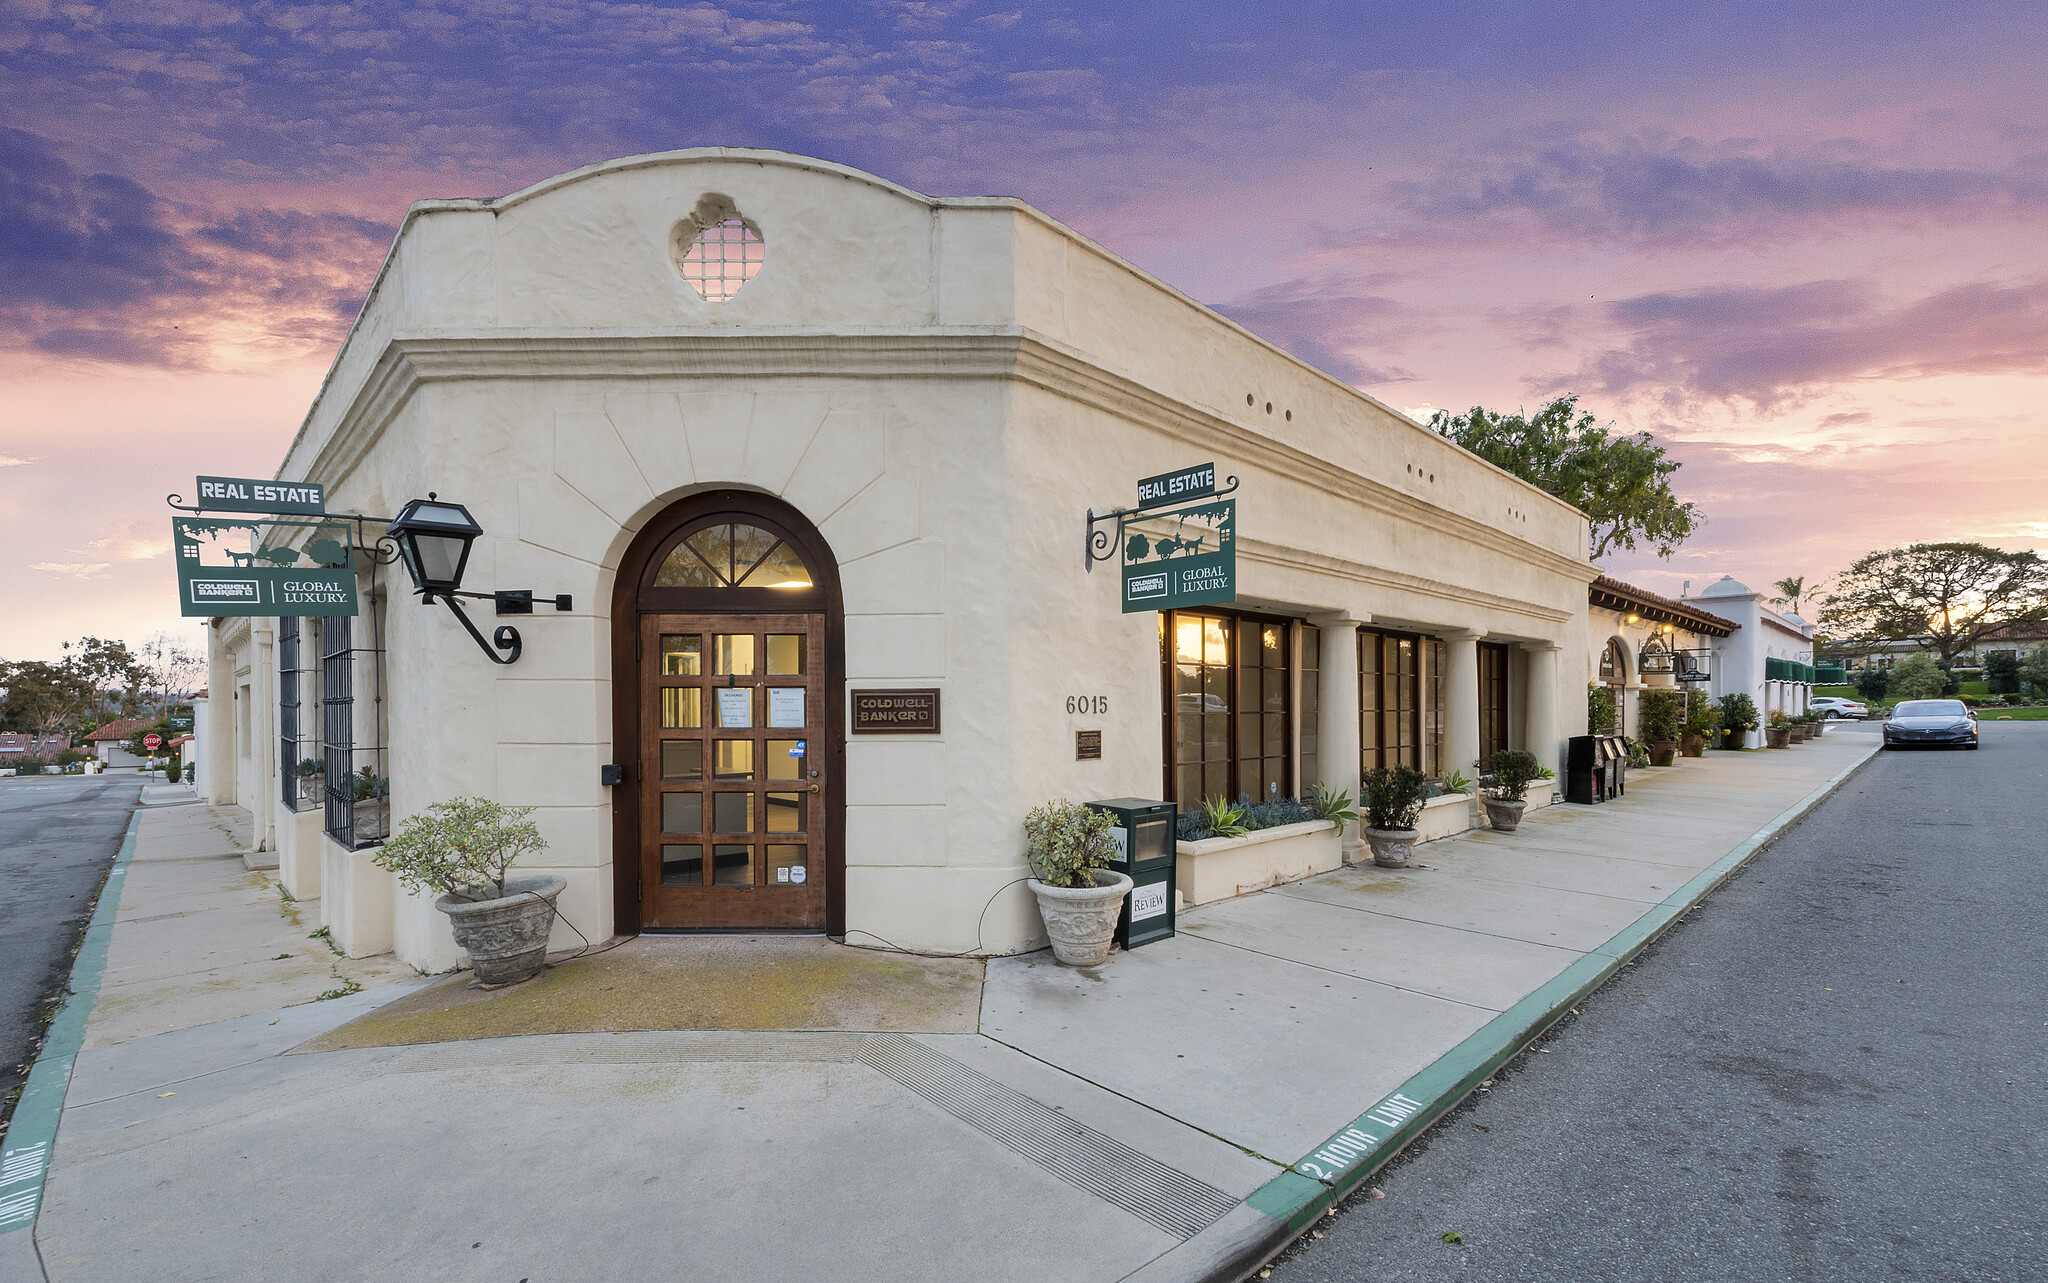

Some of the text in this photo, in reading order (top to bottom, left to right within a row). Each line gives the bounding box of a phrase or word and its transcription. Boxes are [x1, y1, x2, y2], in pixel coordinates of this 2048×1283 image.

[201, 482, 320, 503] REAL ESTATE
[1138, 469, 1213, 501] REAL ESTATE
[1182, 566, 1224, 581] GLOBAL
[283, 581, 342, 592] GLOBAL
[1131, 577, 1164, 587] COLDWELL
[198, 589, 244, 597] BANKER
[861, 699, 929, 708] COLDWELL
[1066, 695, 1108, 714] 6015
[861, 711, 917, 723] BANKER
[1134, 893, 1165, 912] REVIEW
[1301, 1093, 1423, 1180] 2 HOUR LIMIT
